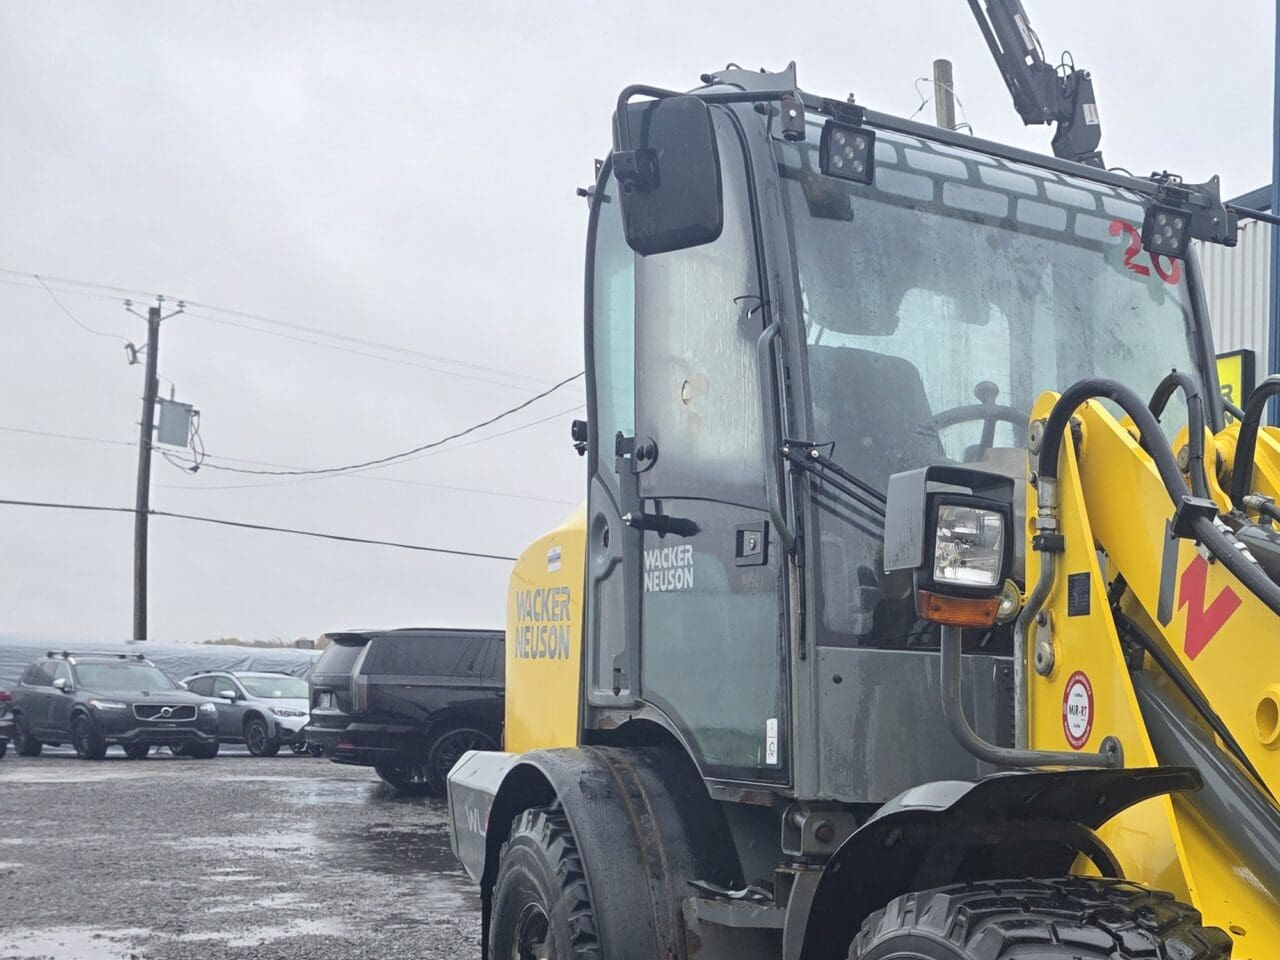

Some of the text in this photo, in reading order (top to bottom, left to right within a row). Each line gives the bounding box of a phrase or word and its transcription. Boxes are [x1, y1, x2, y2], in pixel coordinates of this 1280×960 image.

[643, 544, 694, 571] WACKER
[643, 567, 694, 592] NEUSON
[515, 586, 571, 623] WACKER
[514, 625, 571, 660] NEUSON
